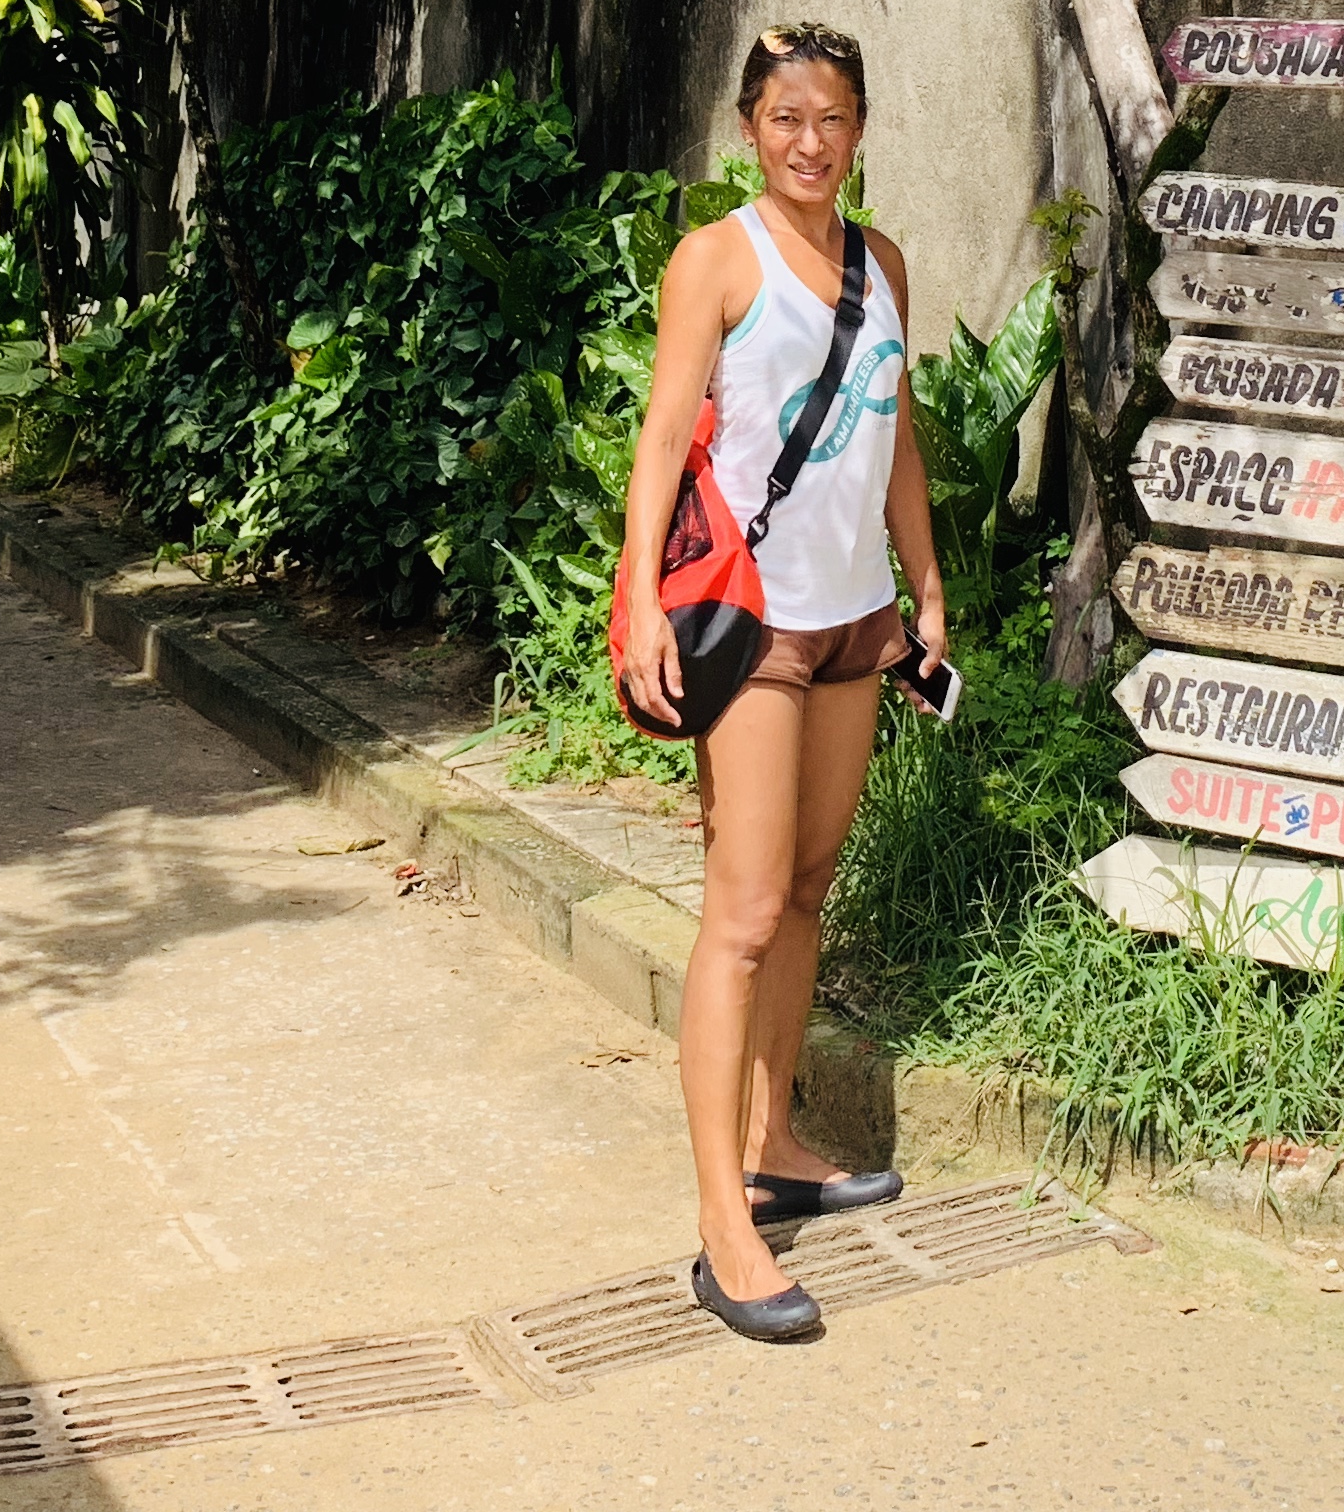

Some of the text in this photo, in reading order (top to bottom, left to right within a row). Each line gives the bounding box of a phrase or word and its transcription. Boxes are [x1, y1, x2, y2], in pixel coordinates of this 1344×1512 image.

[1157, 183, 1338, 241] CAMPING
[825, 350, 881, 456] I AM LIMITLESS
[1179, 353, 1340, 409] POUSADA
[1166, 766, 1285, 833] SUITE
